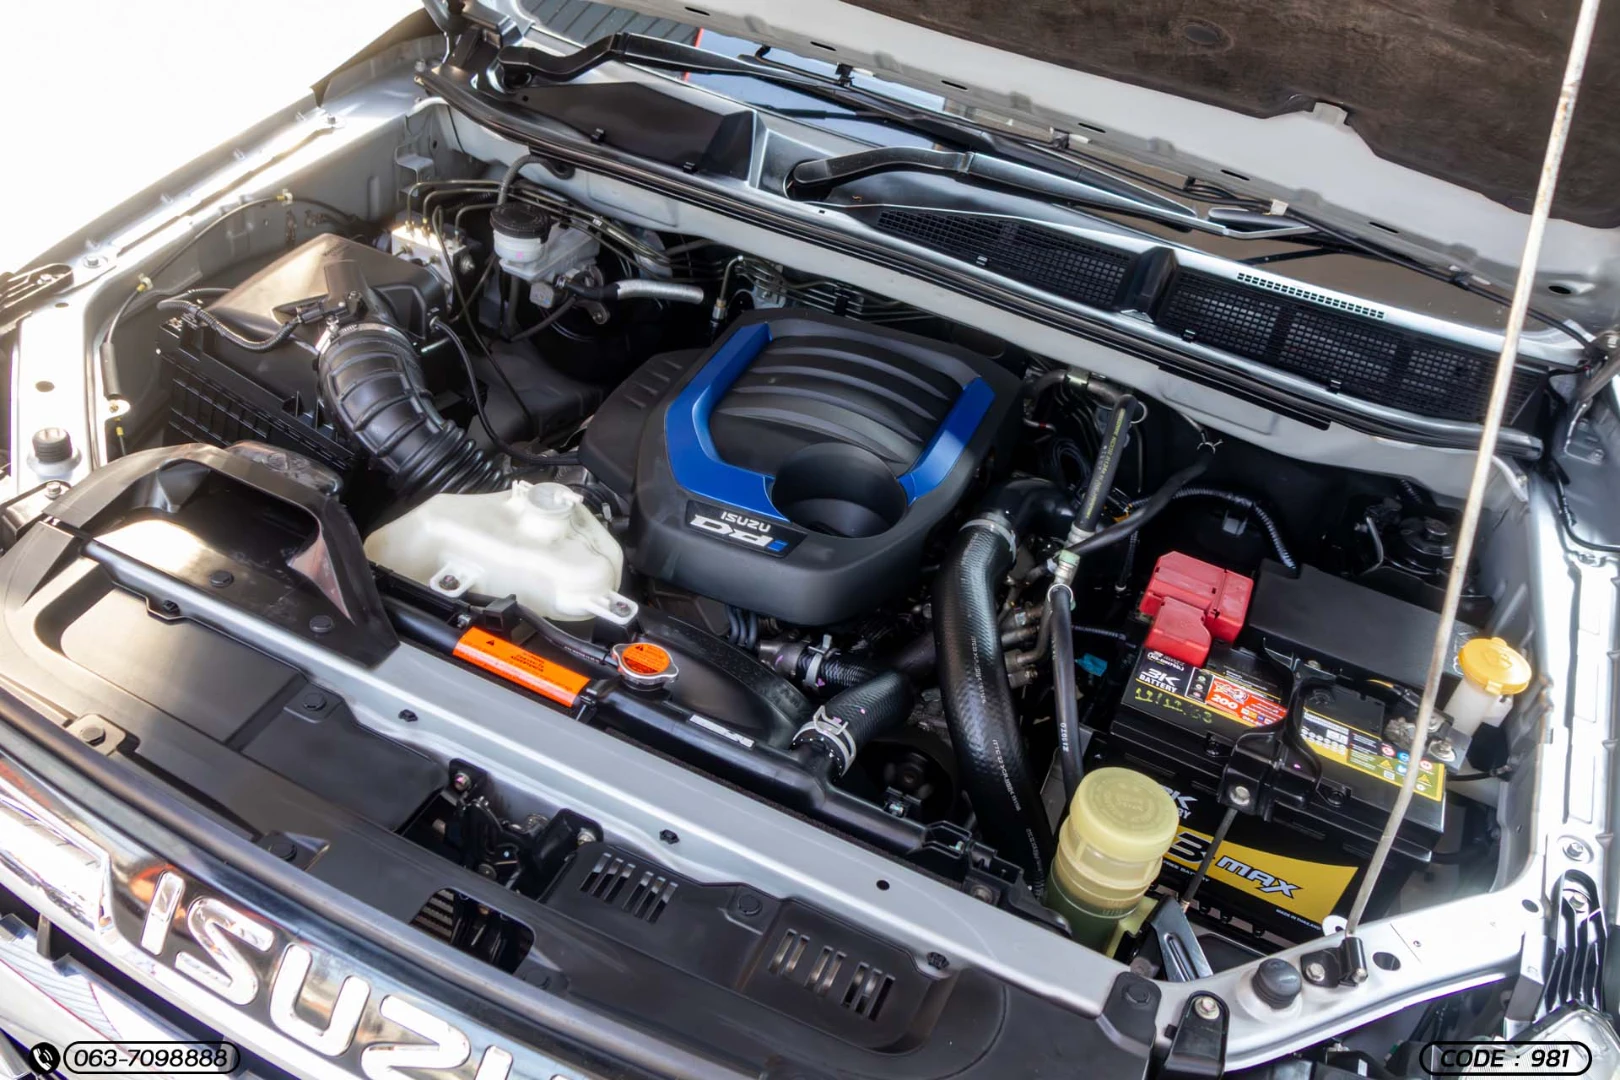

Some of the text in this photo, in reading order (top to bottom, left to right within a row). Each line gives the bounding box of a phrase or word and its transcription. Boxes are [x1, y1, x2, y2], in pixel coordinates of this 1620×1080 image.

[720, 511, 772, 533] ISUZU
[1139, 673, 1178, 693] BATTERY
[1211, 693, 1239, 710] 200
[141, 871, 577, 1080] ISUZ
